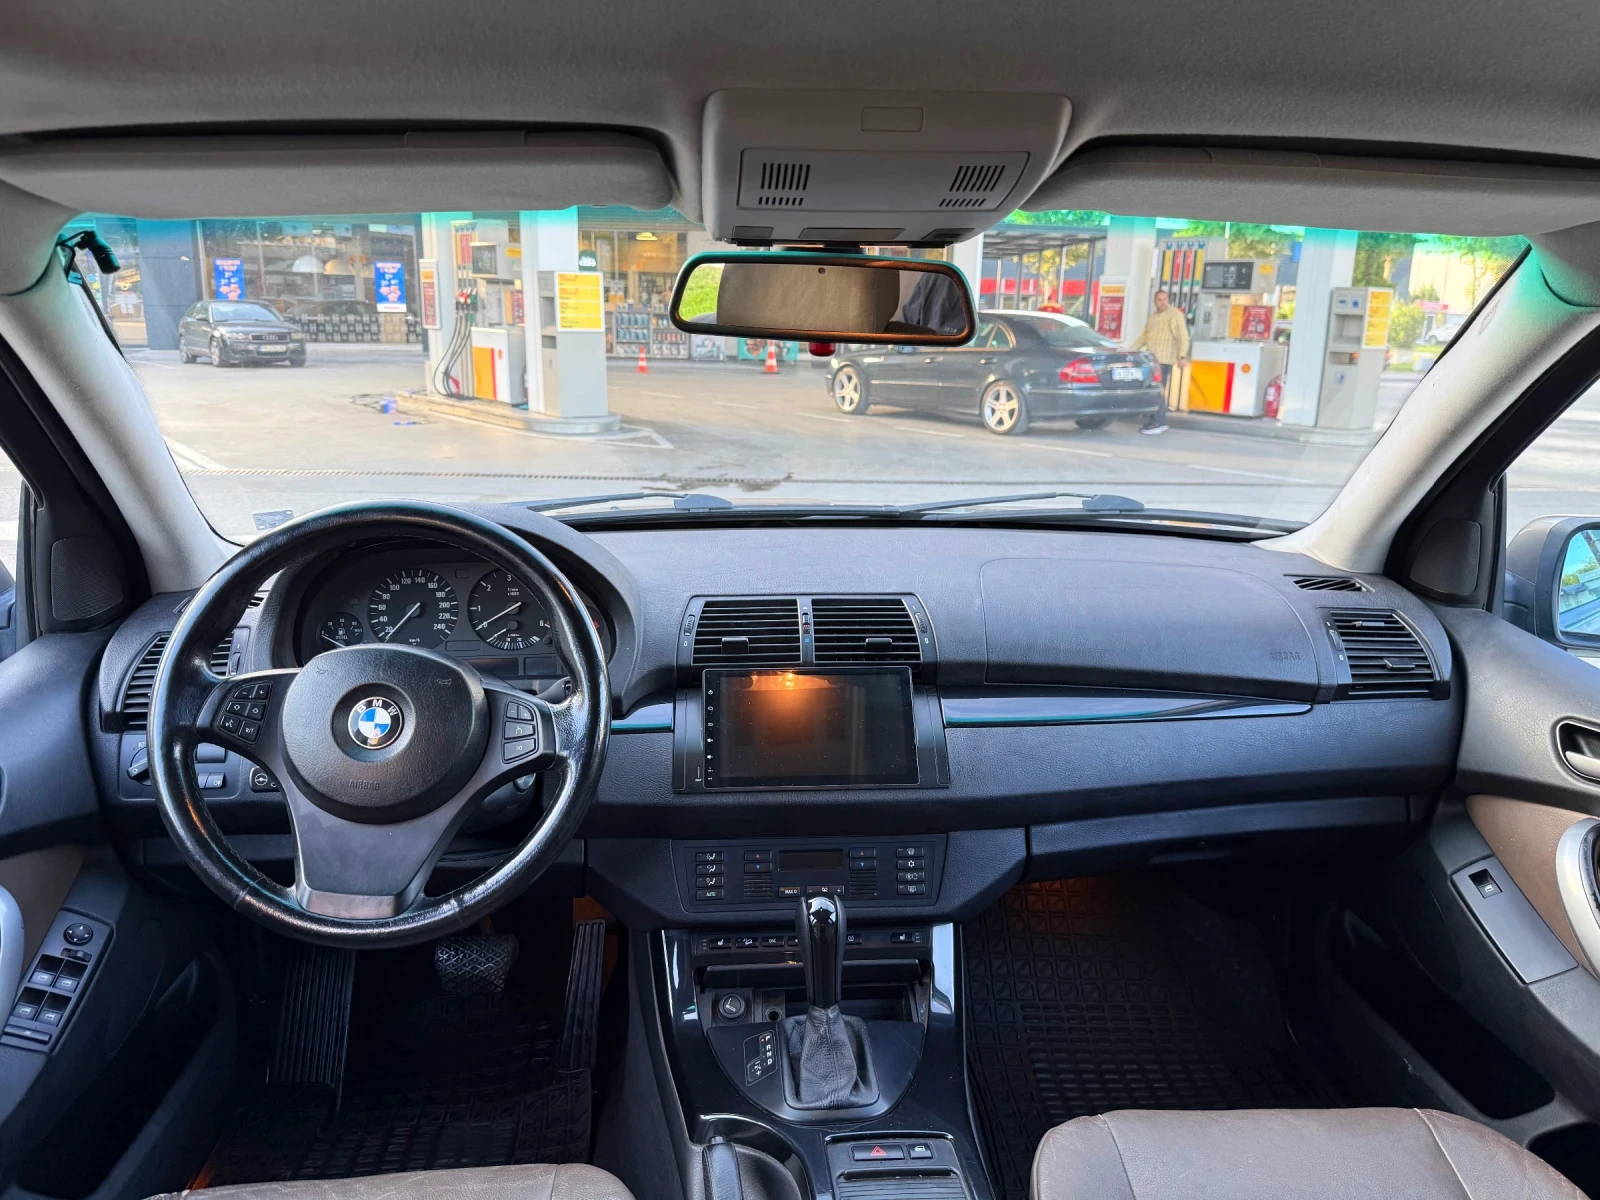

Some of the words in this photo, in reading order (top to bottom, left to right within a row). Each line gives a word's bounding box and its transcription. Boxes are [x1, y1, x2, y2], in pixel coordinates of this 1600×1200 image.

[356, 698, 399, 716] BMW
[350, 780, 380, 791] AIRBAG
[766, 1050, 772, 1058] N
